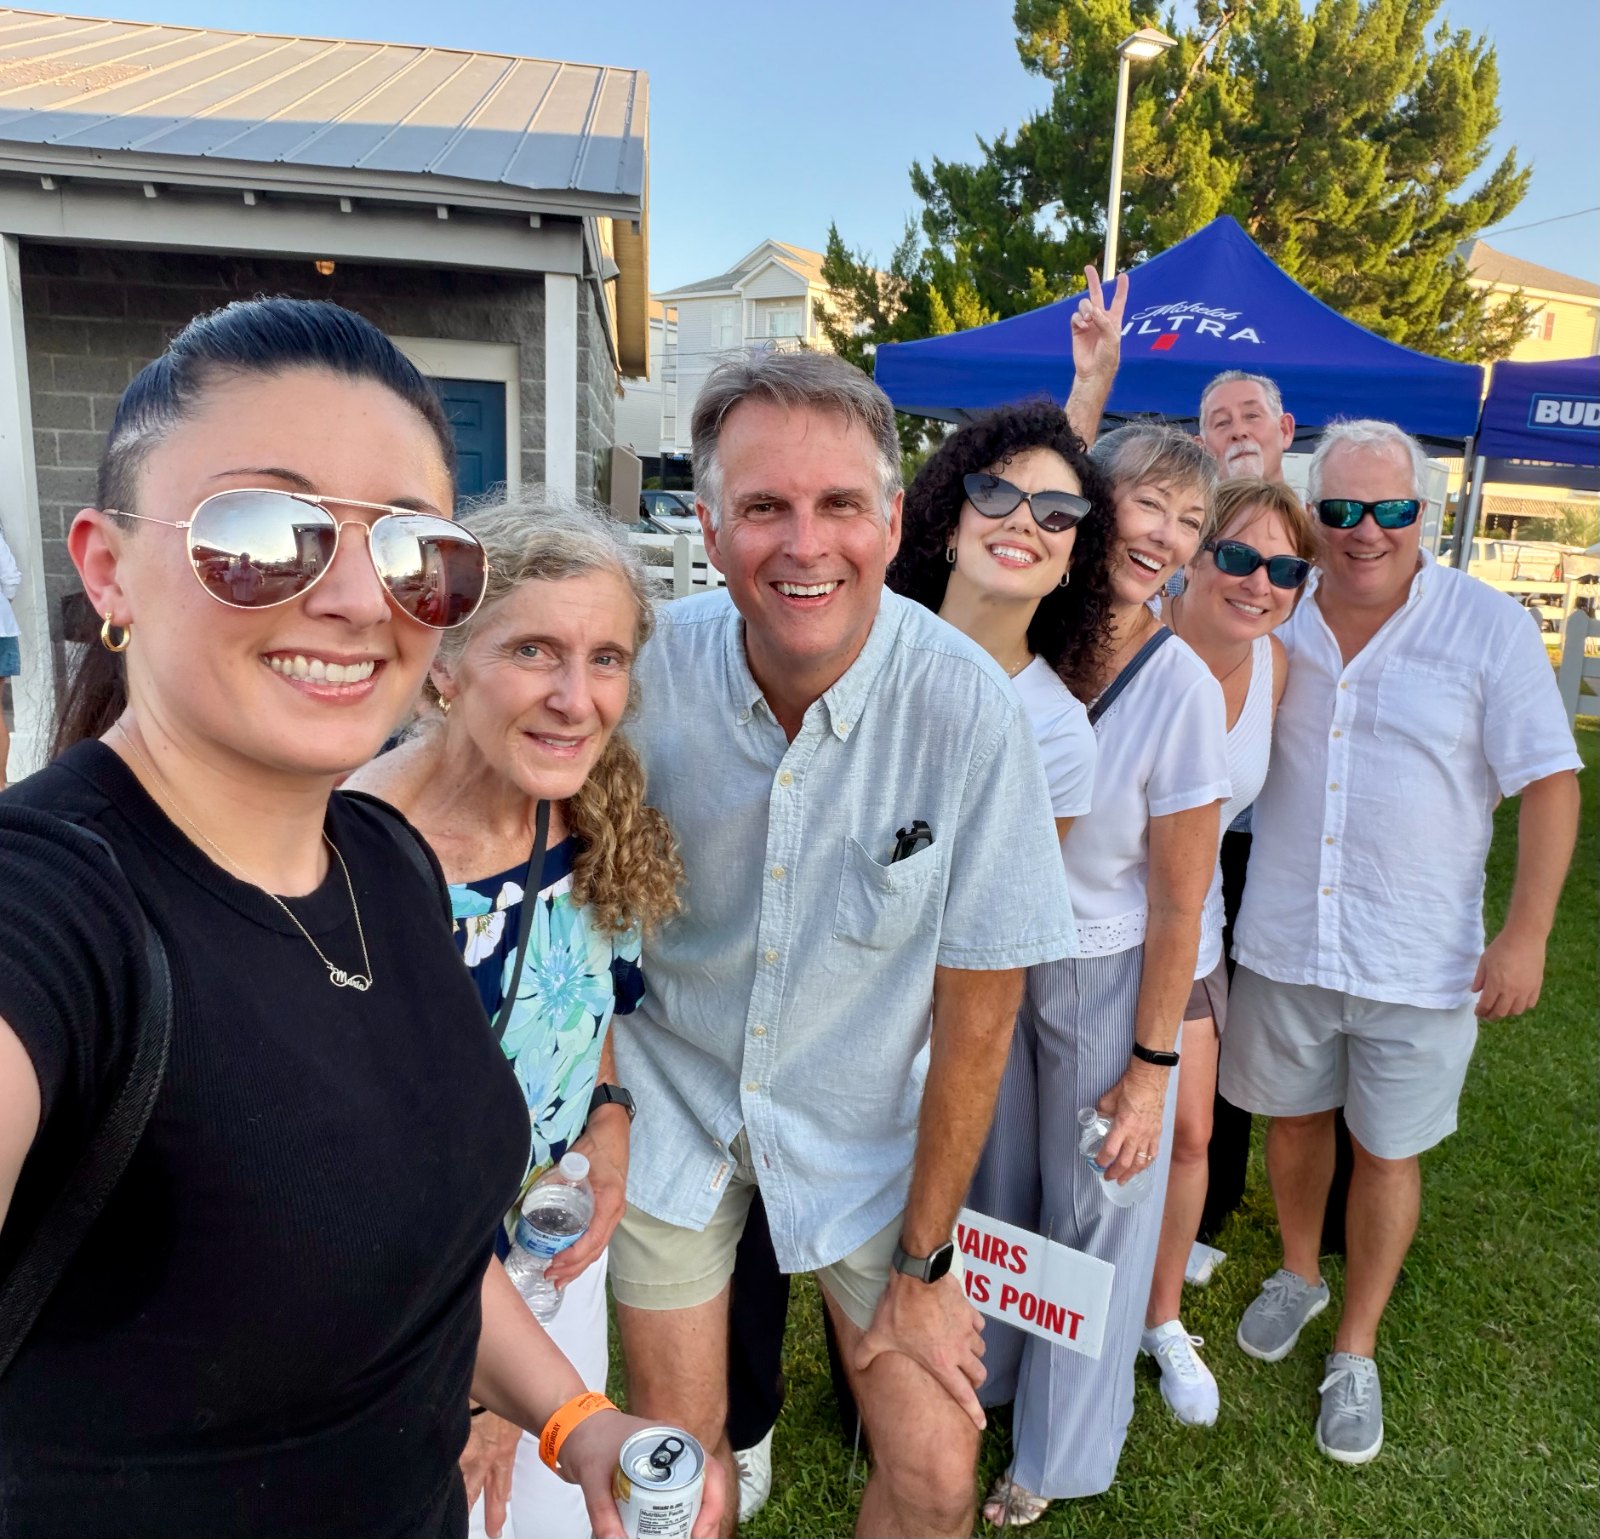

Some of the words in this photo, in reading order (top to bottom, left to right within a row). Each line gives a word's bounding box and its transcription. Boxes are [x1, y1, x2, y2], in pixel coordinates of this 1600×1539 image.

[1131, 300, 1243, 320] Michelob
[957, 1223, 1028, 1275] AIRS
[999, 1283, 1085, 1341] POINT
